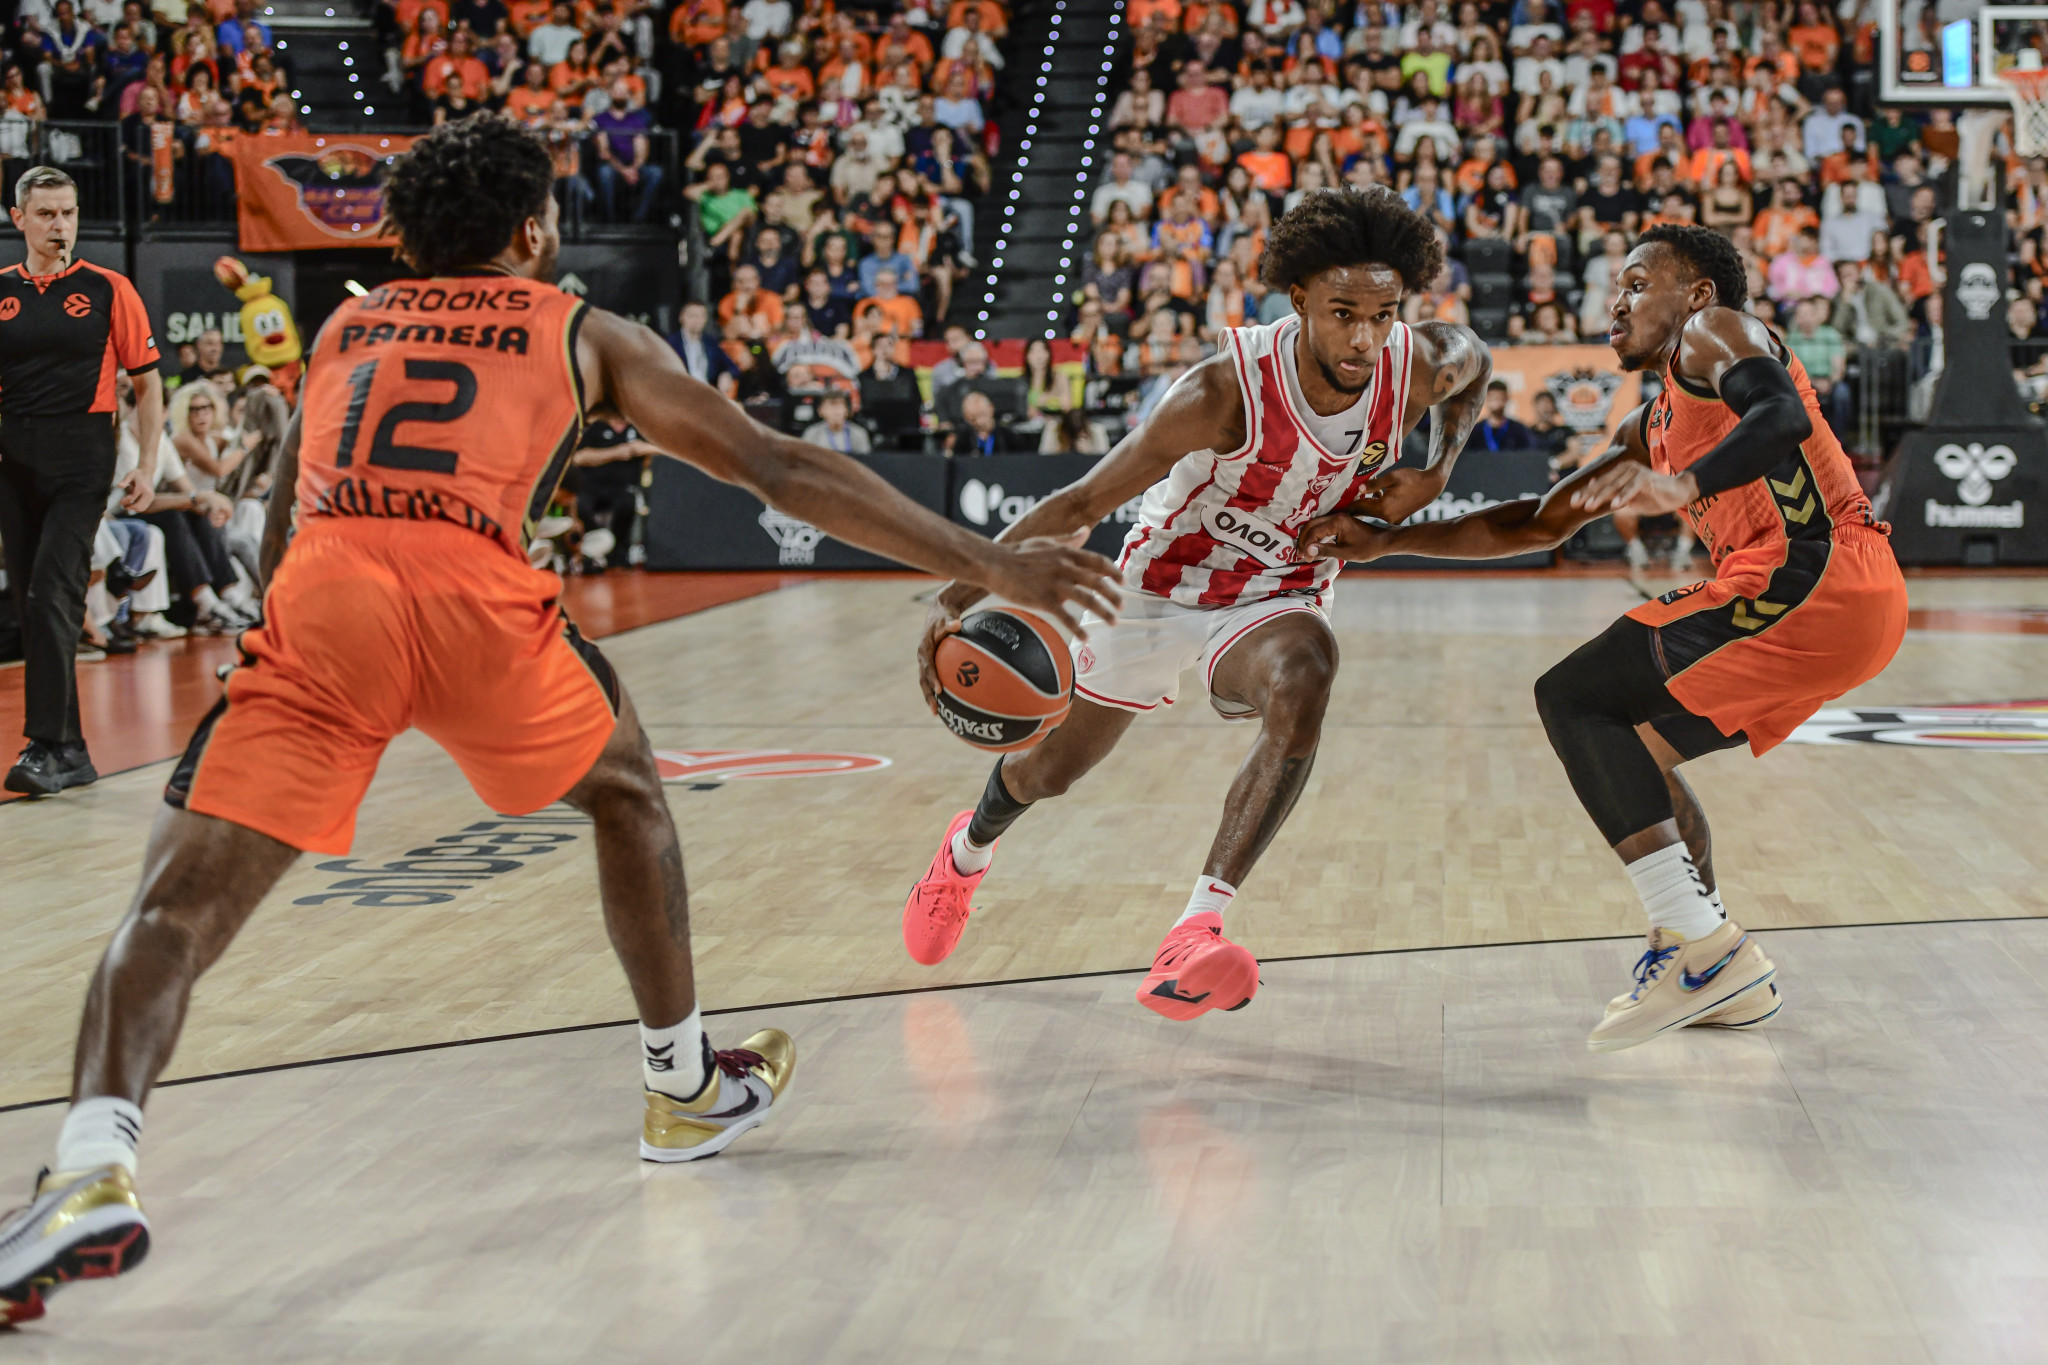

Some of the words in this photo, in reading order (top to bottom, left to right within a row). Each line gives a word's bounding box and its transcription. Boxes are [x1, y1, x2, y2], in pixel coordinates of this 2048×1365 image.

[361, 289, 531, 312] BROOKS
[339, 322, 530, 355] PAMESA
[335, 357, 478, 476] 12
[1925, 498, 2024, 529] hummel
